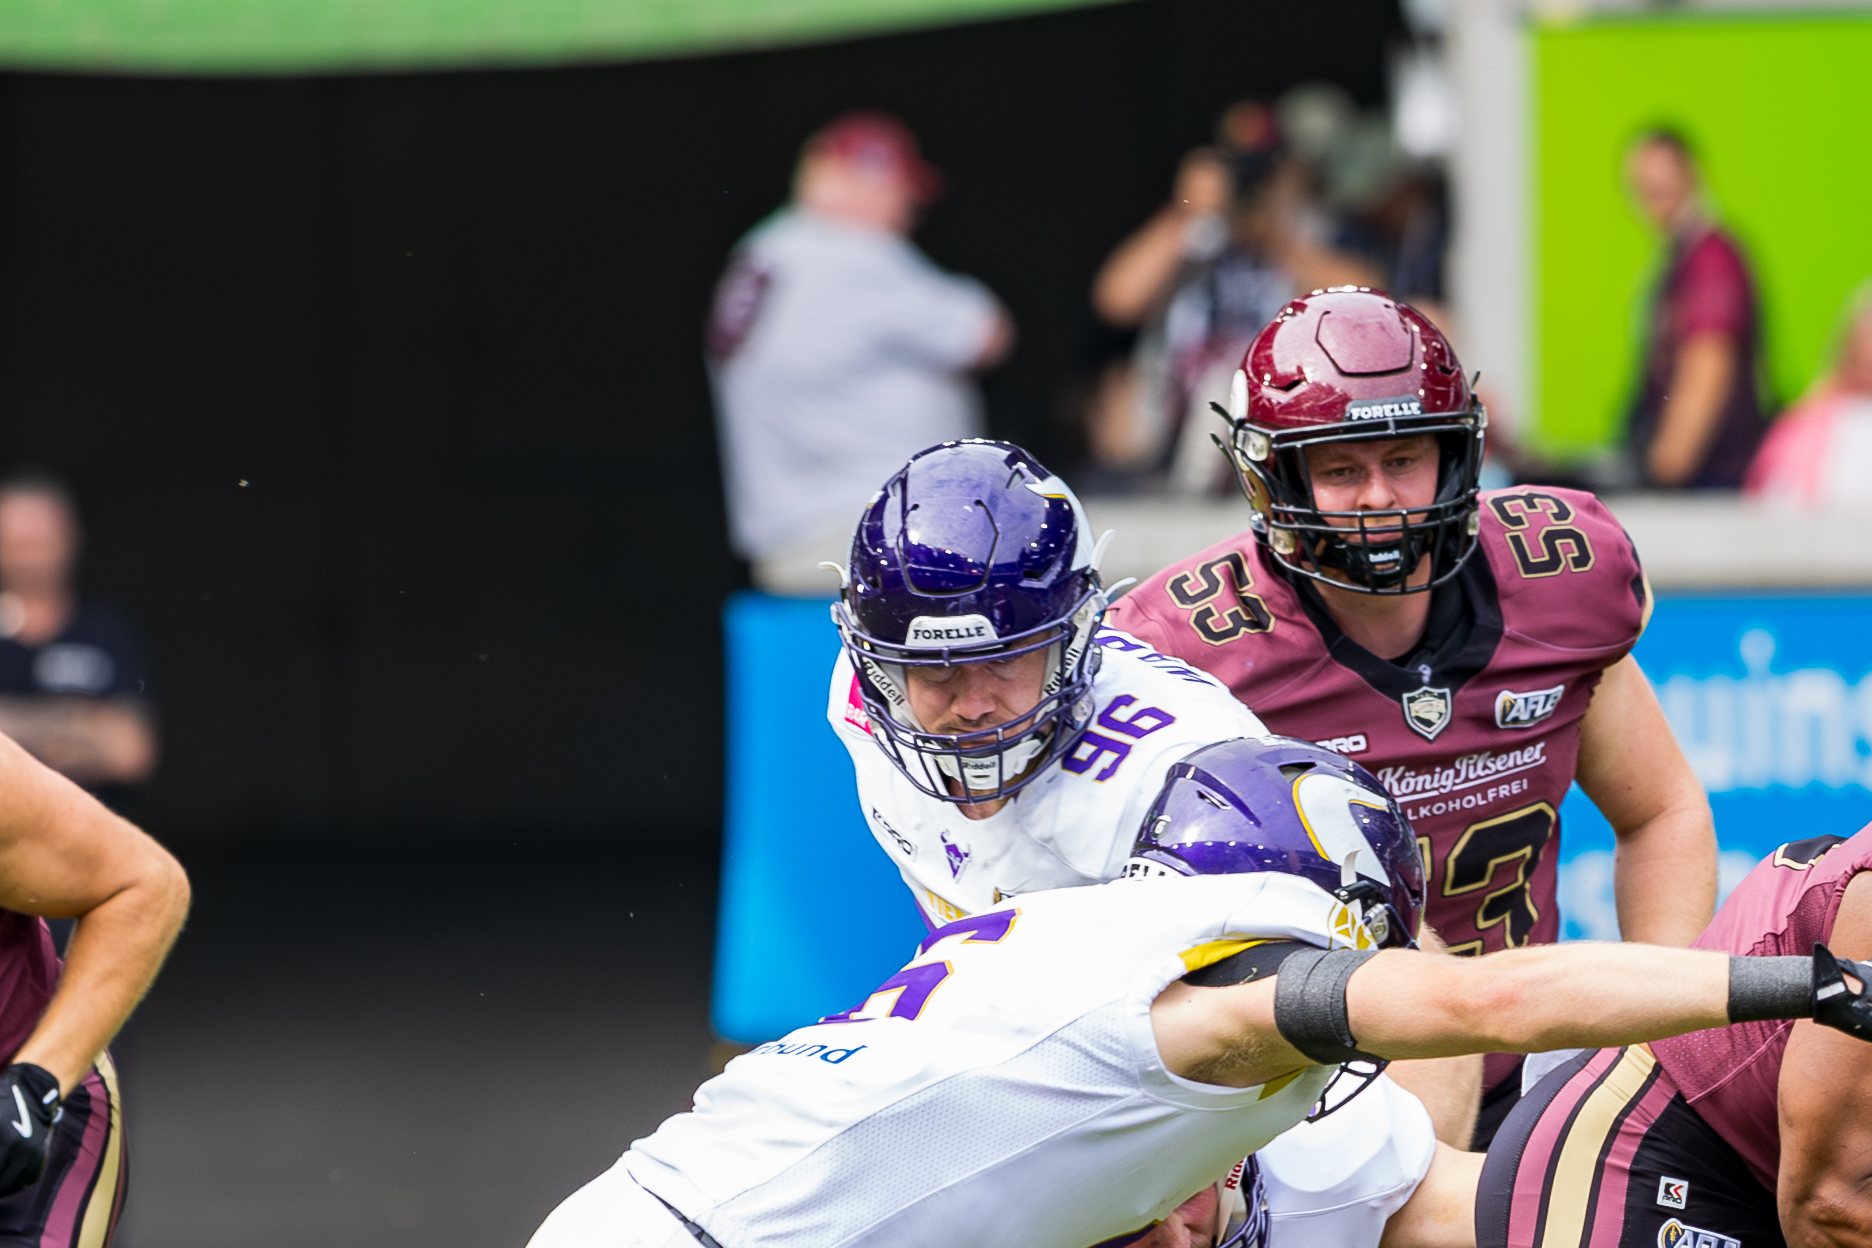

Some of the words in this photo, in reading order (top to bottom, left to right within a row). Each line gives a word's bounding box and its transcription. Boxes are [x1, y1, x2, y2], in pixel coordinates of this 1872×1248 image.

[1350, 402, 1421, 420] FORELLE
[1486, 490, 1596, 579] 53
[913, 626, 986, 640] FORELLE
[1165, 550, 1276, 647] 53
[1060, 694, 1177, 785] 96
[1407, 778, 1528, 821] LKOHOLFREI
[1416, 802, 1556, 956] 3
